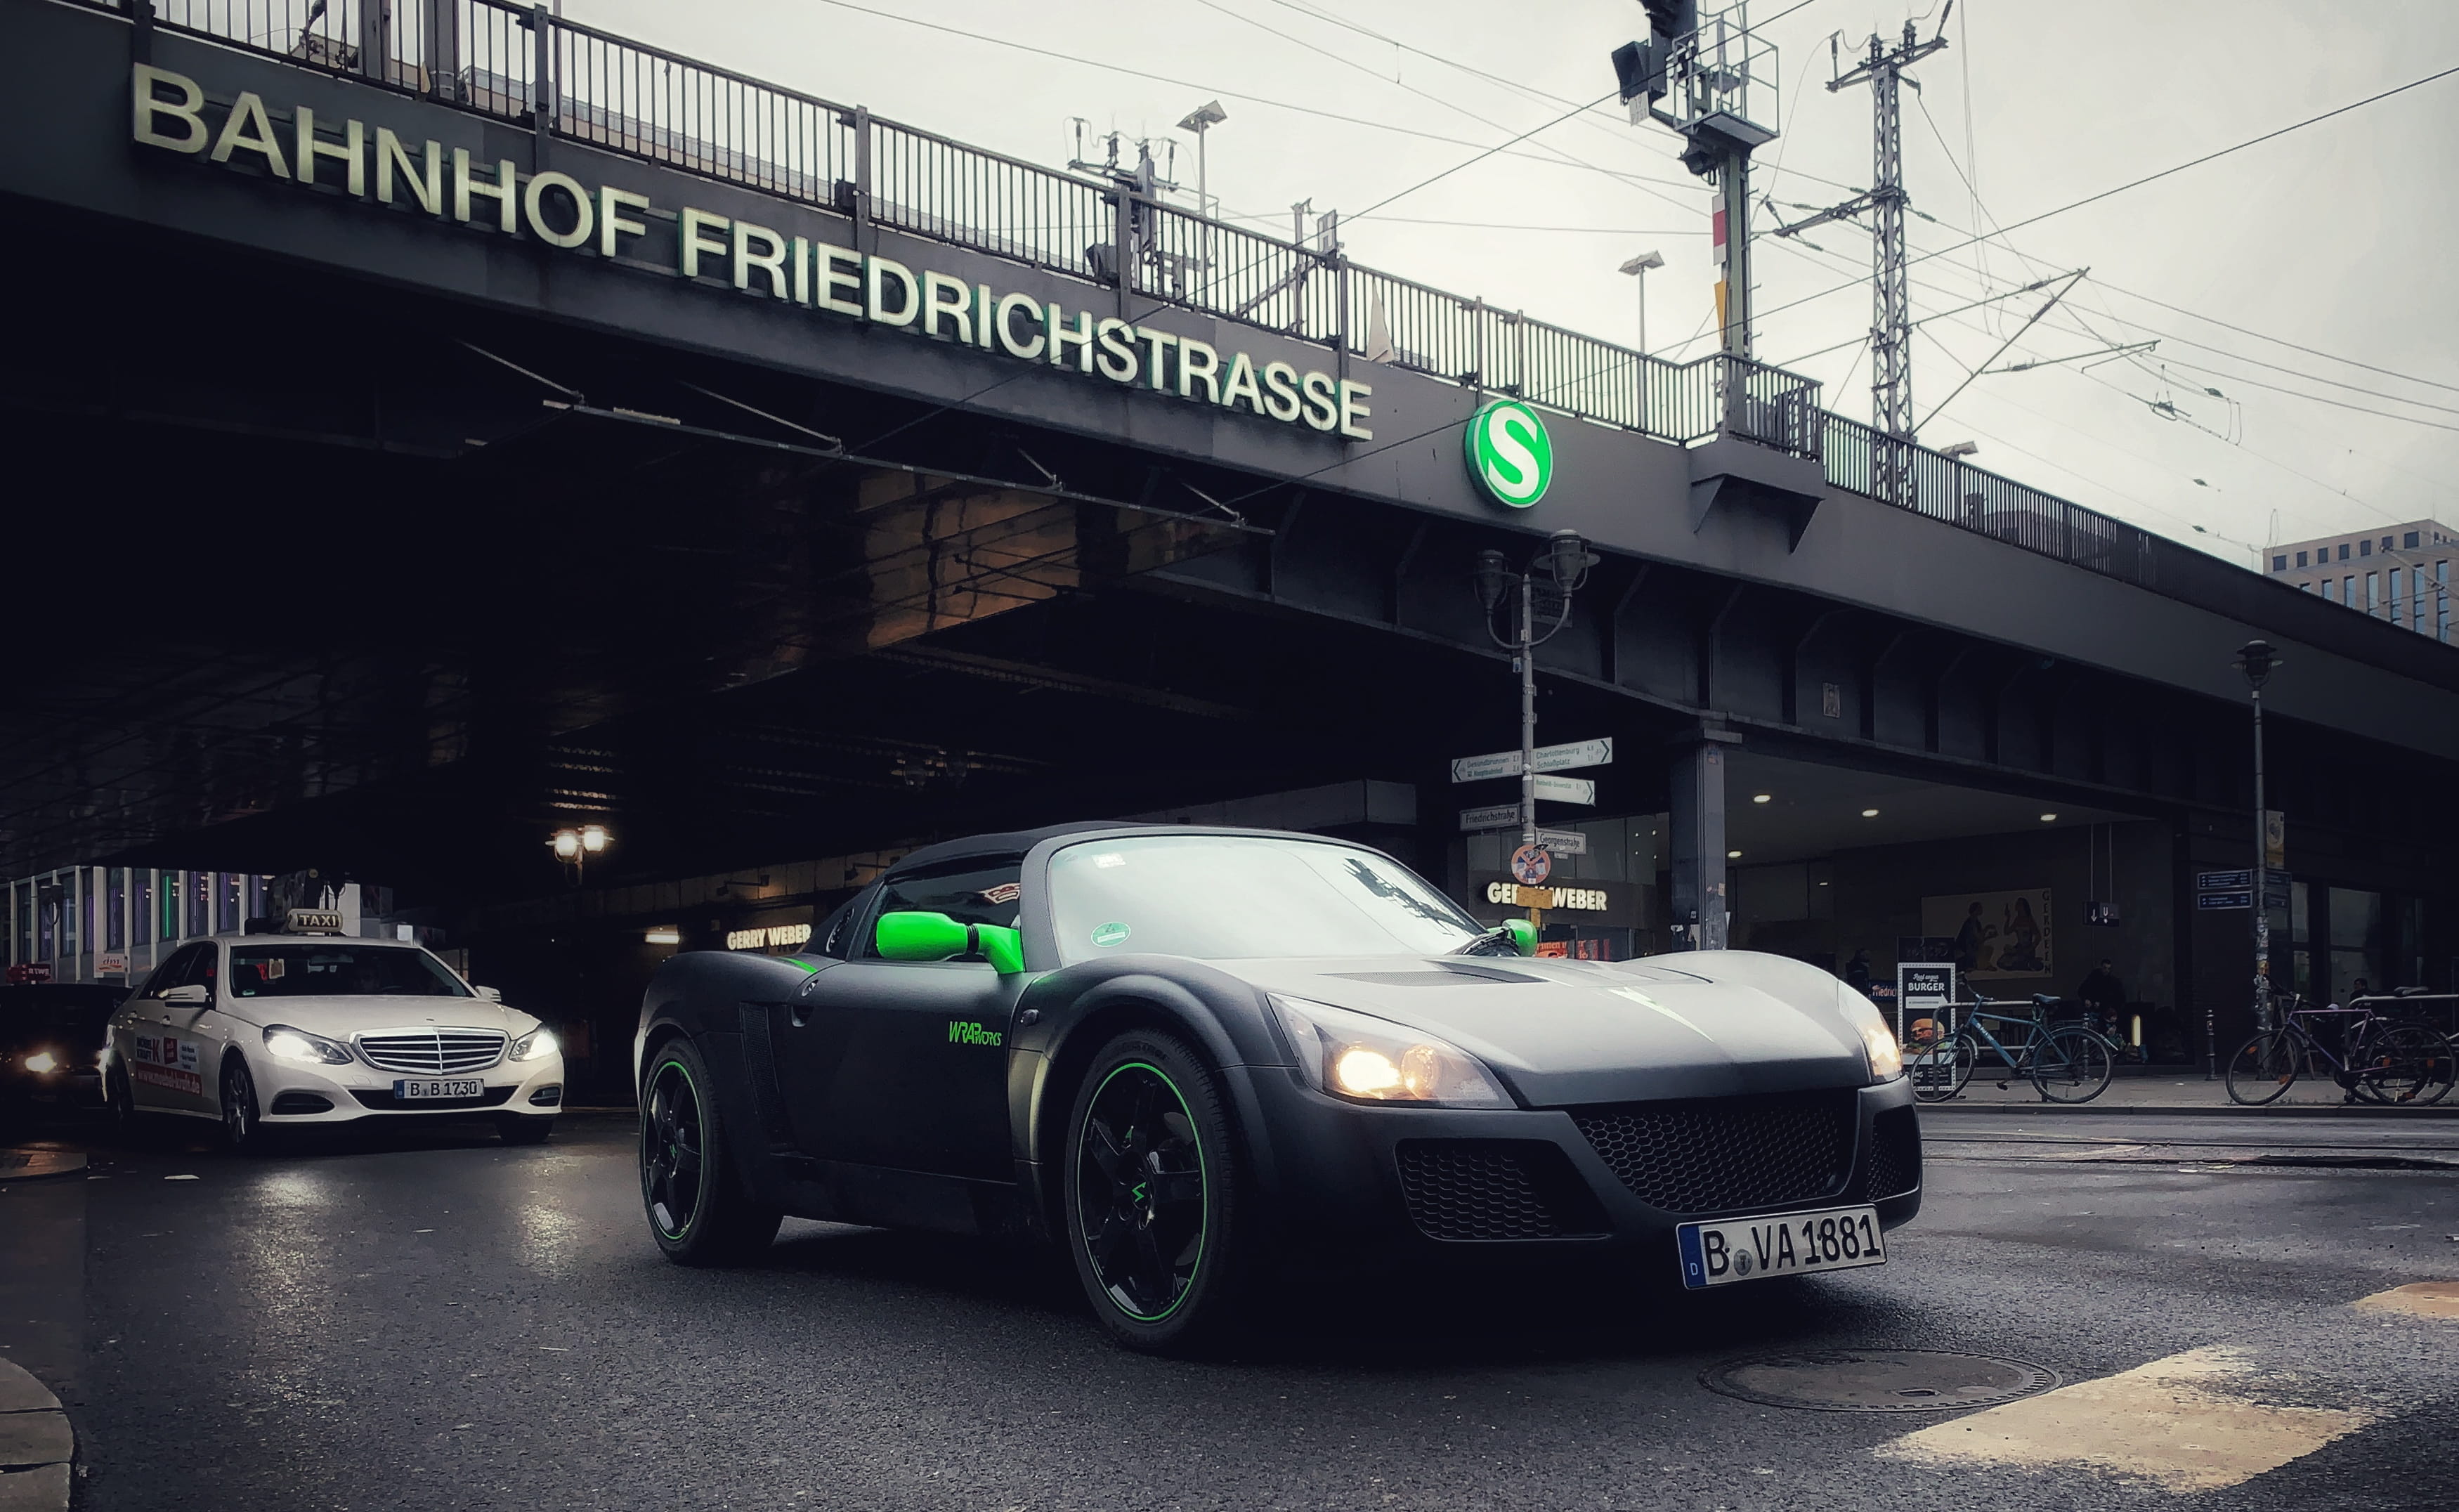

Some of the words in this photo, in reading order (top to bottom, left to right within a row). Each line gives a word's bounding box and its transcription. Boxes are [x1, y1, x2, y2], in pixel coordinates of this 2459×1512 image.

[132, 62, 651, 259] BAHNHOF
[680, 205, 1375, 443] FRIEDRICHSTRASSE
[1487, 410, 1541, 500] S
[1536, 747, 1580, 760] Charlottenburg
[1466, 809, 1515, 824] Friedrichstraße
[1539, 833, 1580, 849] Georgenstraße
[1550, 886, 1607, 911] WEBER
[299, 915, 337, 927] TAXI
[727, 927, 767, 951] GERRY
[767, 923, 811, 947] WEBER
[1907, 982, 1945, 991] BURGER
[410, 1083, 420, 1096] B
[431, 1083, 440, 1095] B
[443, 1081, 477, 1095] 1730
[1703, 1230, 1730, 1277] B
[1751, 1223, 1796, 1270] VA
[1802, 1214, 1881, 1265] 1881
